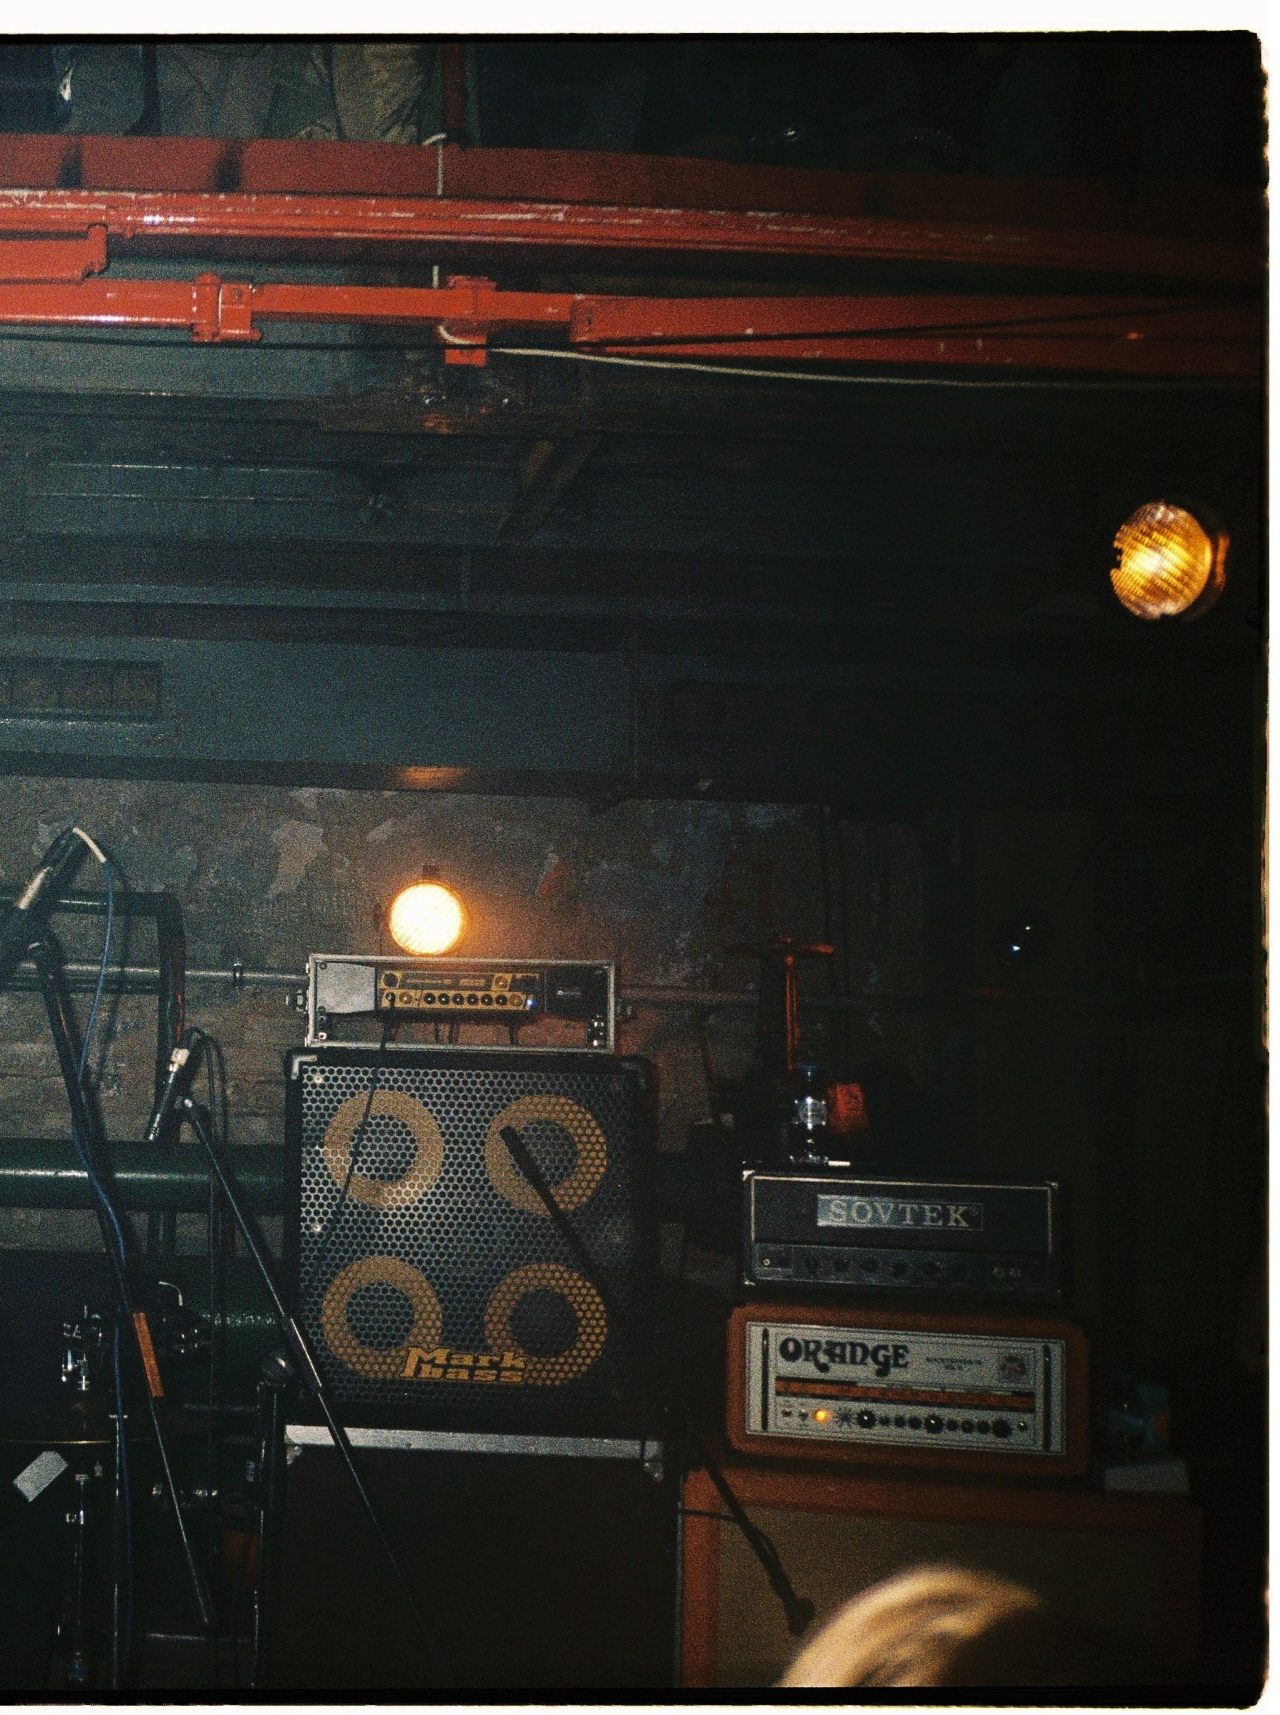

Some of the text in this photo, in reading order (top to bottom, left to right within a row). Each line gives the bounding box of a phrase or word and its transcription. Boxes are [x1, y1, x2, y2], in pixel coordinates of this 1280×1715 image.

[829, 1199, 969, 1227] SOVTEK
[401, 1347, 526, 1377] Mark
[779, 1337, 909, 1377] ORANGE
